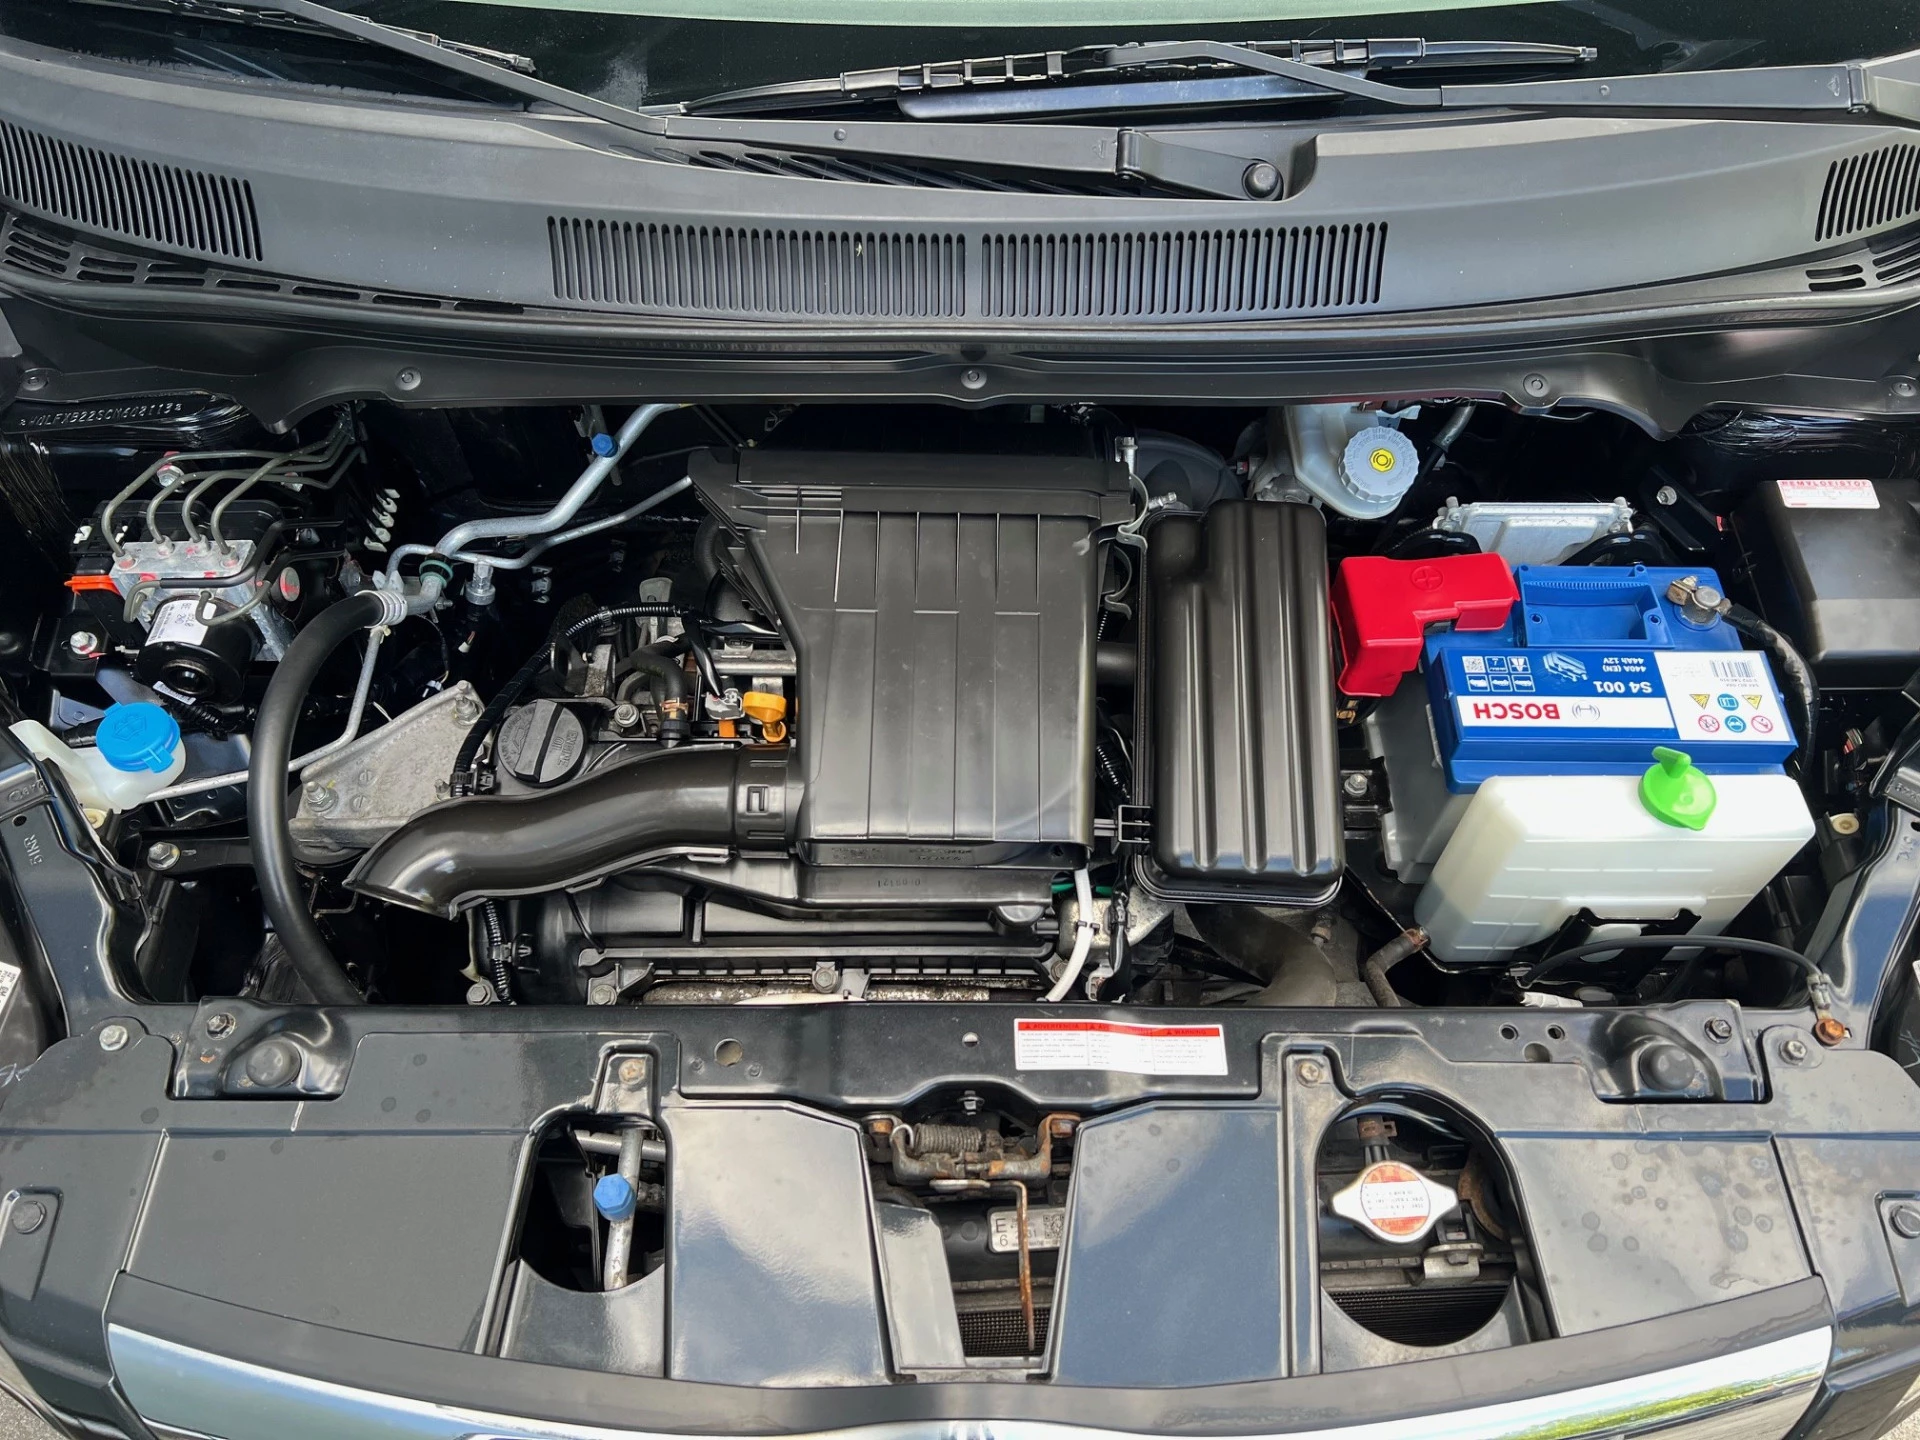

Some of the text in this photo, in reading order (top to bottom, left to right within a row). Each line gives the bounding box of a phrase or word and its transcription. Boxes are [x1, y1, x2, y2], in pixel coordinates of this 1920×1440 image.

[1603, 657, 1620, 665] 12V
[1623, 665, 1647, 673] 440A
[1592, 681, 1653, 694] S4 001
[1473, 703, 1561, 720] BOSCH
[996, 1218, 1007, 1233] E
[1000, 1233, 1009, 1247] 6
